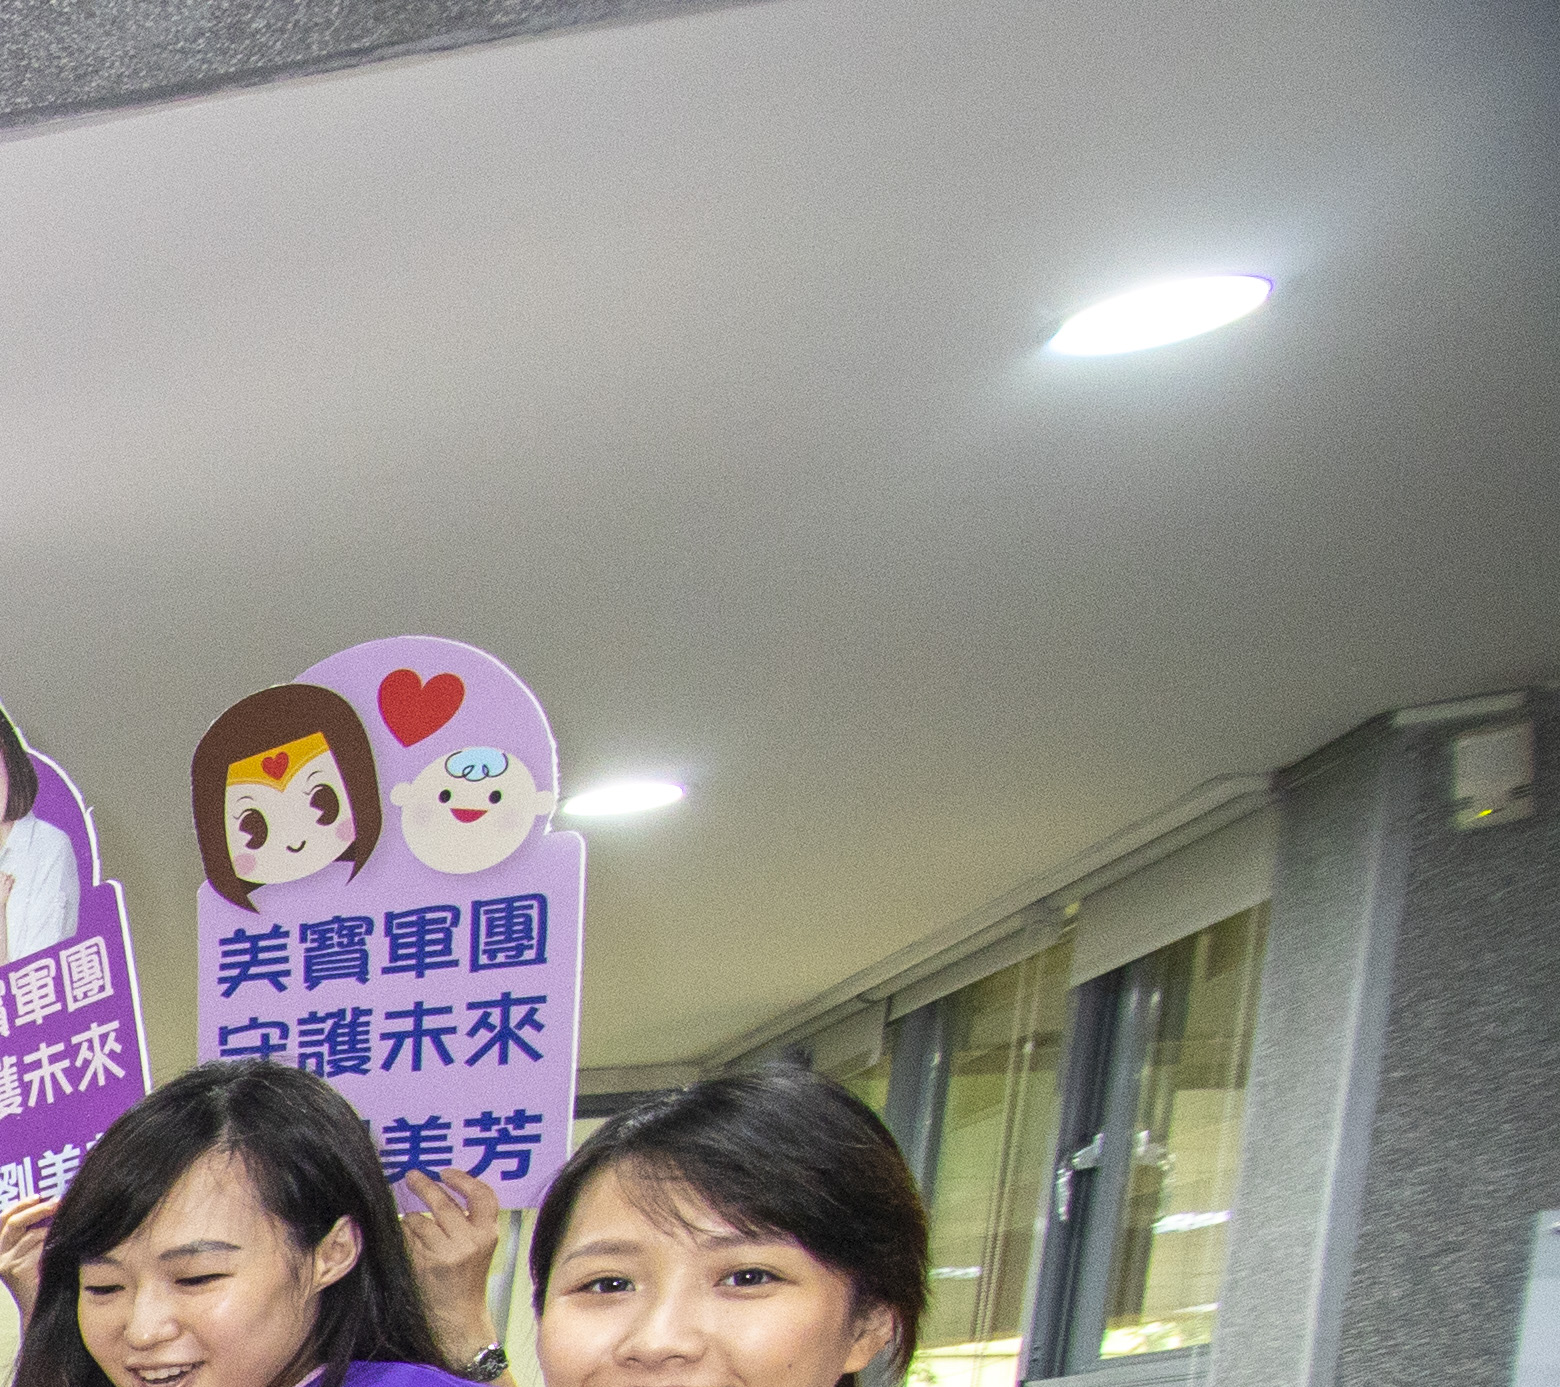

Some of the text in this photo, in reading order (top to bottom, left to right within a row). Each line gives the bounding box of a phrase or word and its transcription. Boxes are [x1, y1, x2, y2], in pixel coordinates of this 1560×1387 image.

[217, 893, 549, 998] 美寶軍團
[217, 991, 548, 1079] 守護未來
[340, 1109, 543, 1184] 美芳
